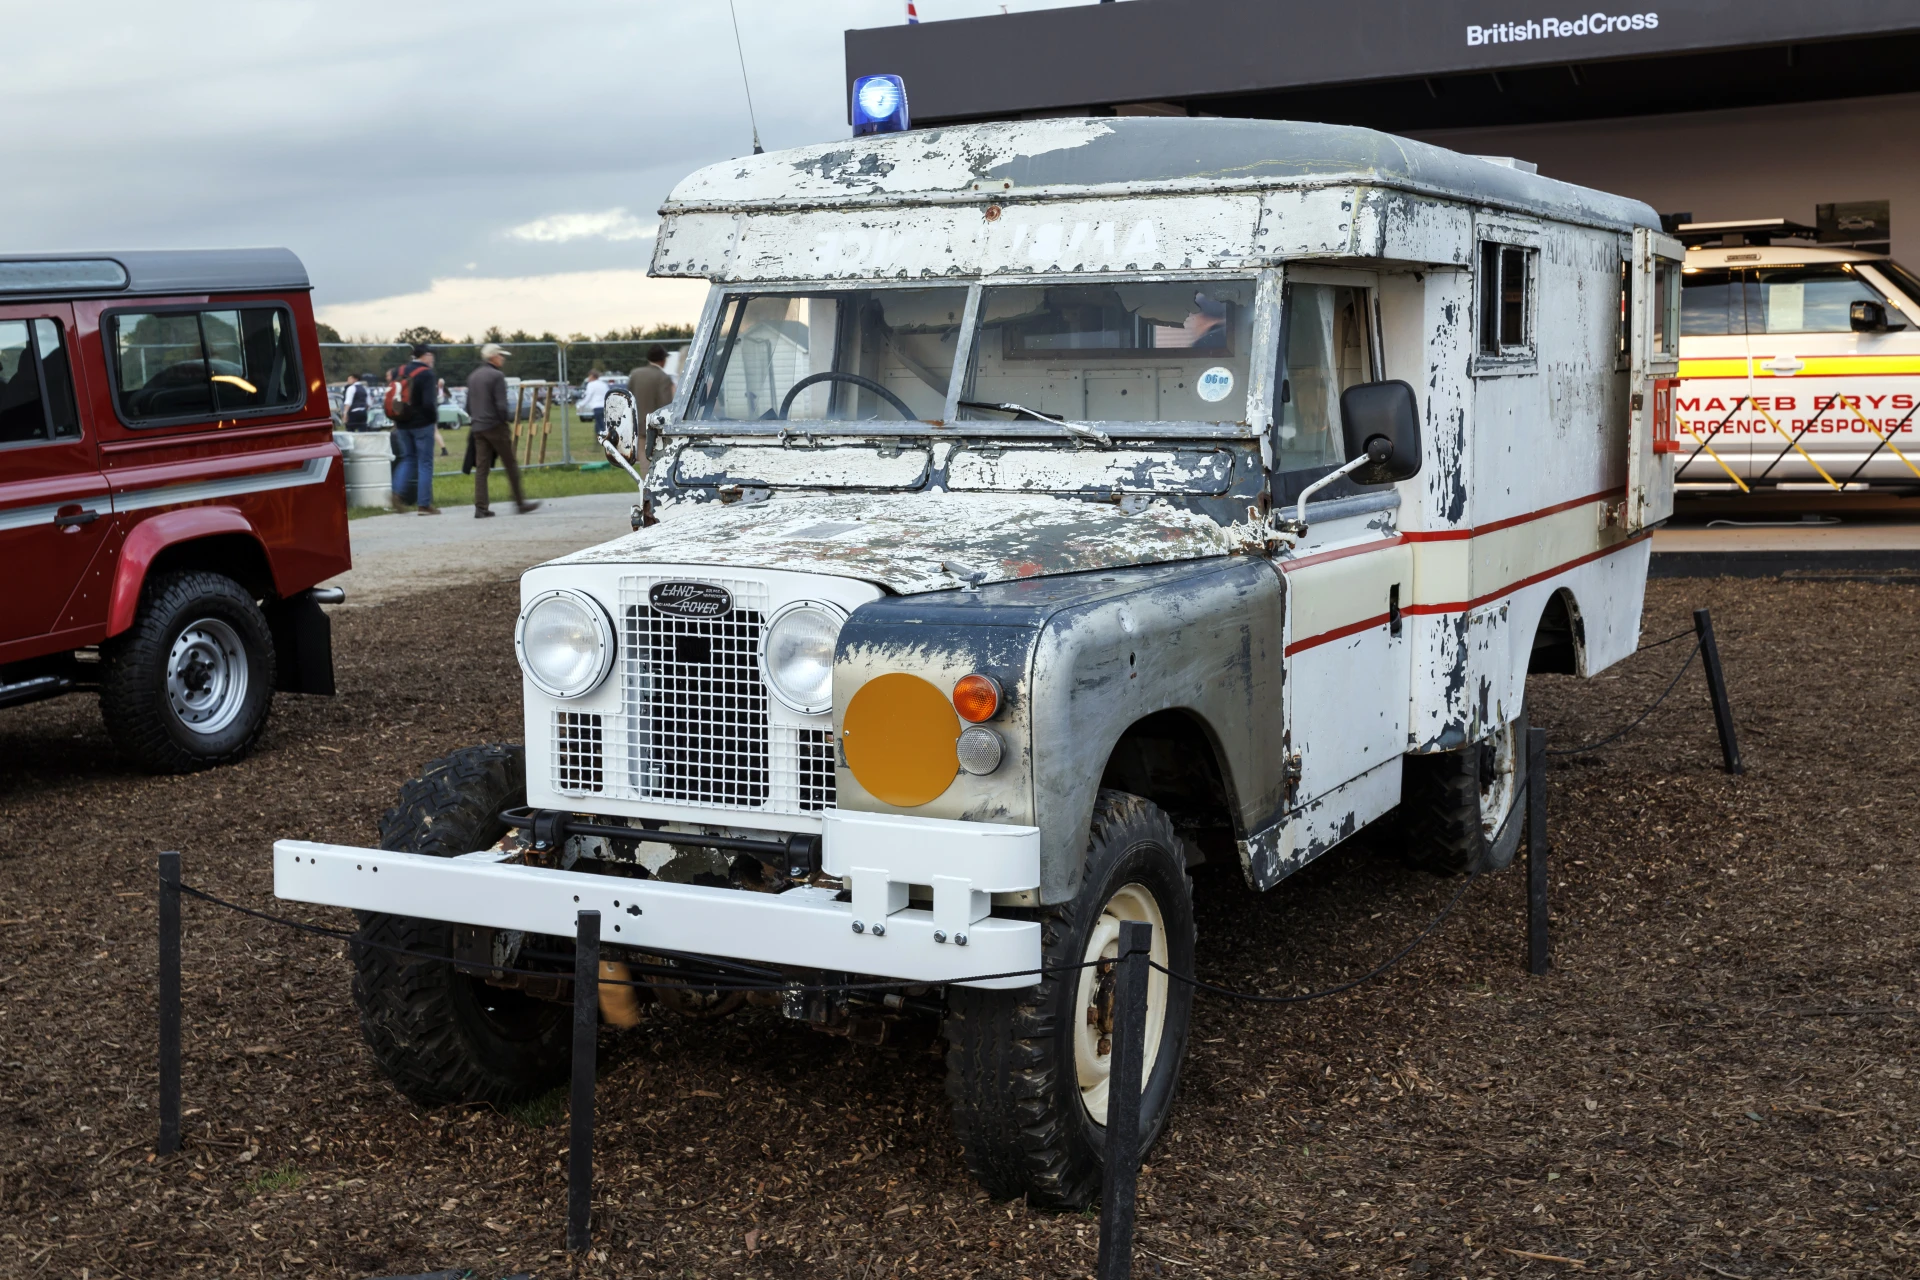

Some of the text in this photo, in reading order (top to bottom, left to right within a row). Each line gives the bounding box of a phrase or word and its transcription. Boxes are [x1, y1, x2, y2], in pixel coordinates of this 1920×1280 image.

[1466, 12, 1659, 46] BritishRedCross
[1814, 394, 1914, 411] BRYS
[1675, 418, 1913, 434] ERGENCY RESPONSE
[662, 585, 694, 597] LAND
[680, 601, 719, 614] ROVER
